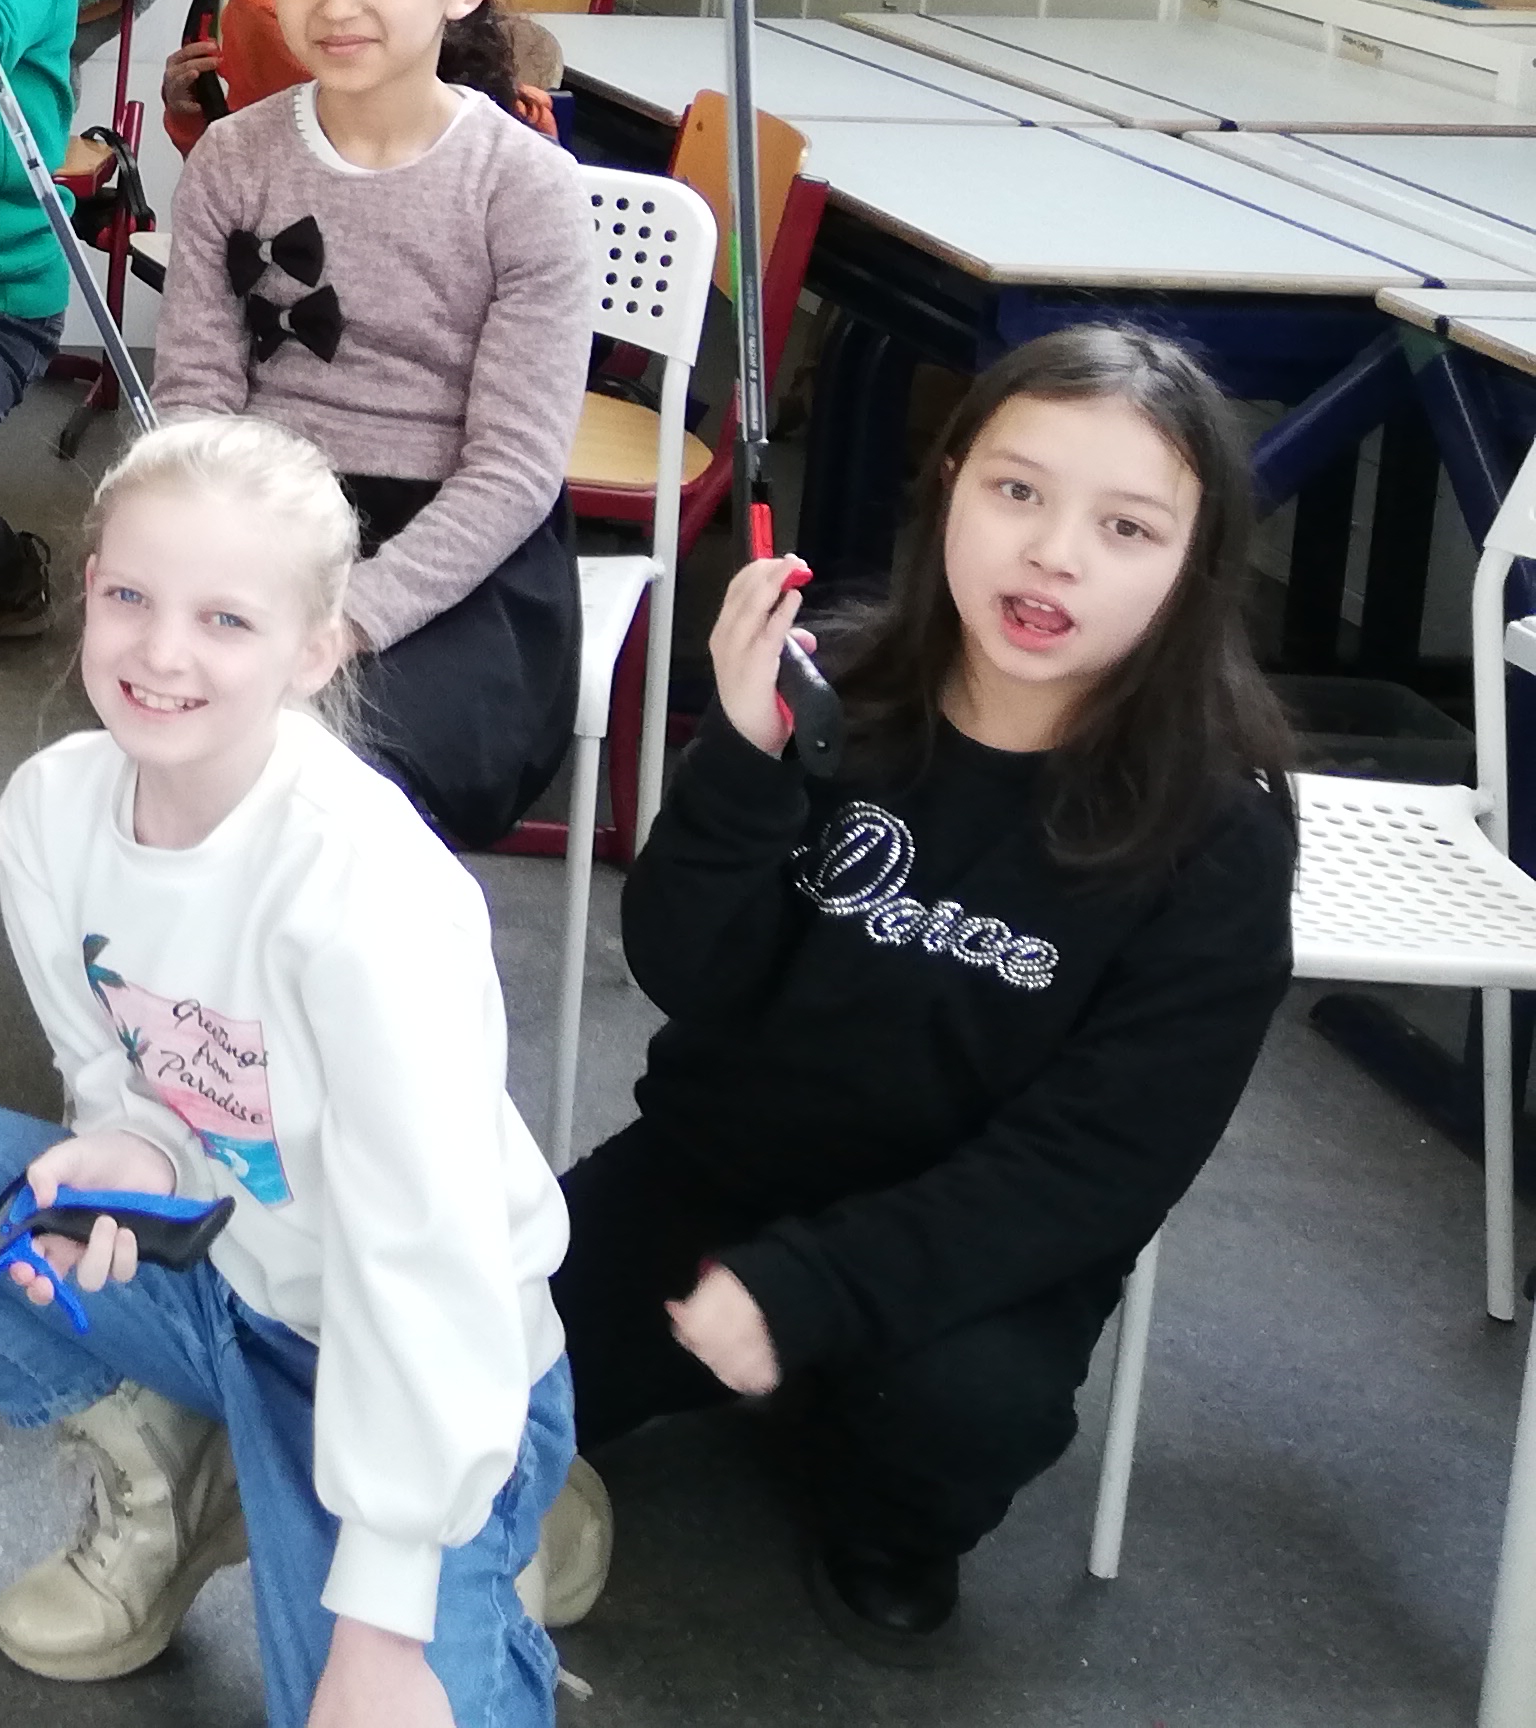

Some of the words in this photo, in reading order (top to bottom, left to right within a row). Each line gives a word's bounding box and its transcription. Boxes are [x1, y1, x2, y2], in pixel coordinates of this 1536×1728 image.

[790, 800, 1060, 991] Dance
[171, 997, 270, 1070] Greetings
[191, 1040, 232, 1084] from
[157, 1049, 266, 1126] Paradise
